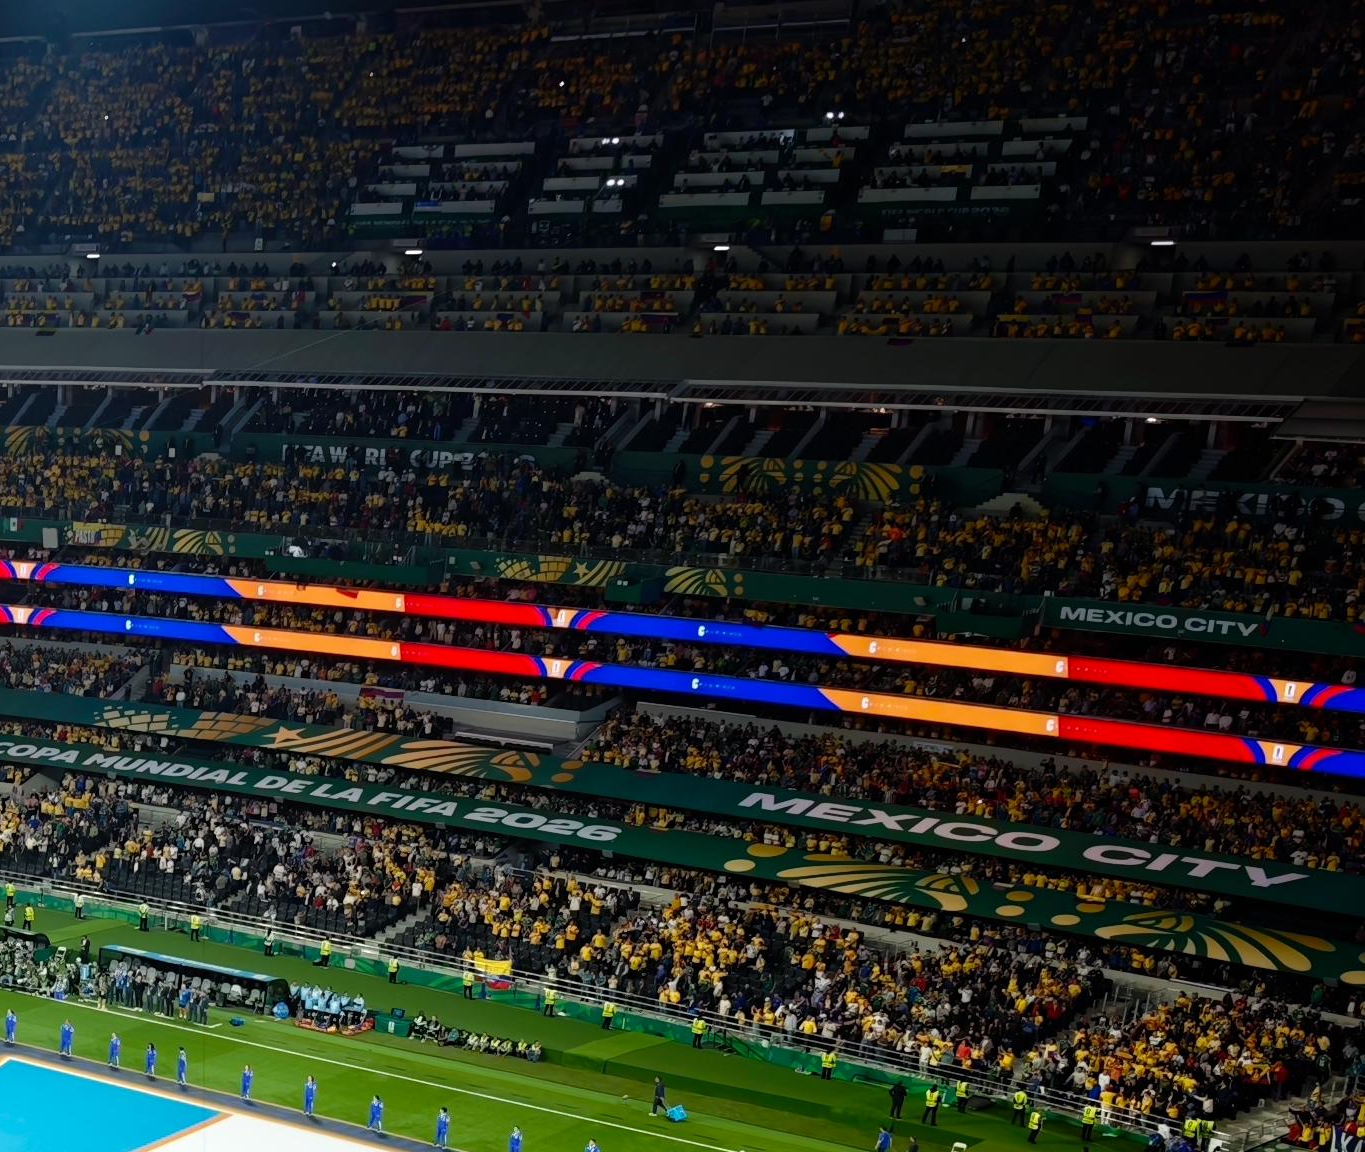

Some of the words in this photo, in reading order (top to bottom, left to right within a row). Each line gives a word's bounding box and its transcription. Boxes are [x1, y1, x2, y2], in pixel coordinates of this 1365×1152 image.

[1059, 605, 1178, 628] MEXICO
[1184, 617, 1259, 637] CITY
[82, 753, 248, 785] MUNDIAL
[254, 775, 308, 794] DE
[309, 782, 364, 802] LA
[367, 791, 458, 817] FIFA
[464, 806, 622, 841] 2026
[737, 792, 1060, 852] MEXICO
[1082, 844, 1309, 888] CITY
